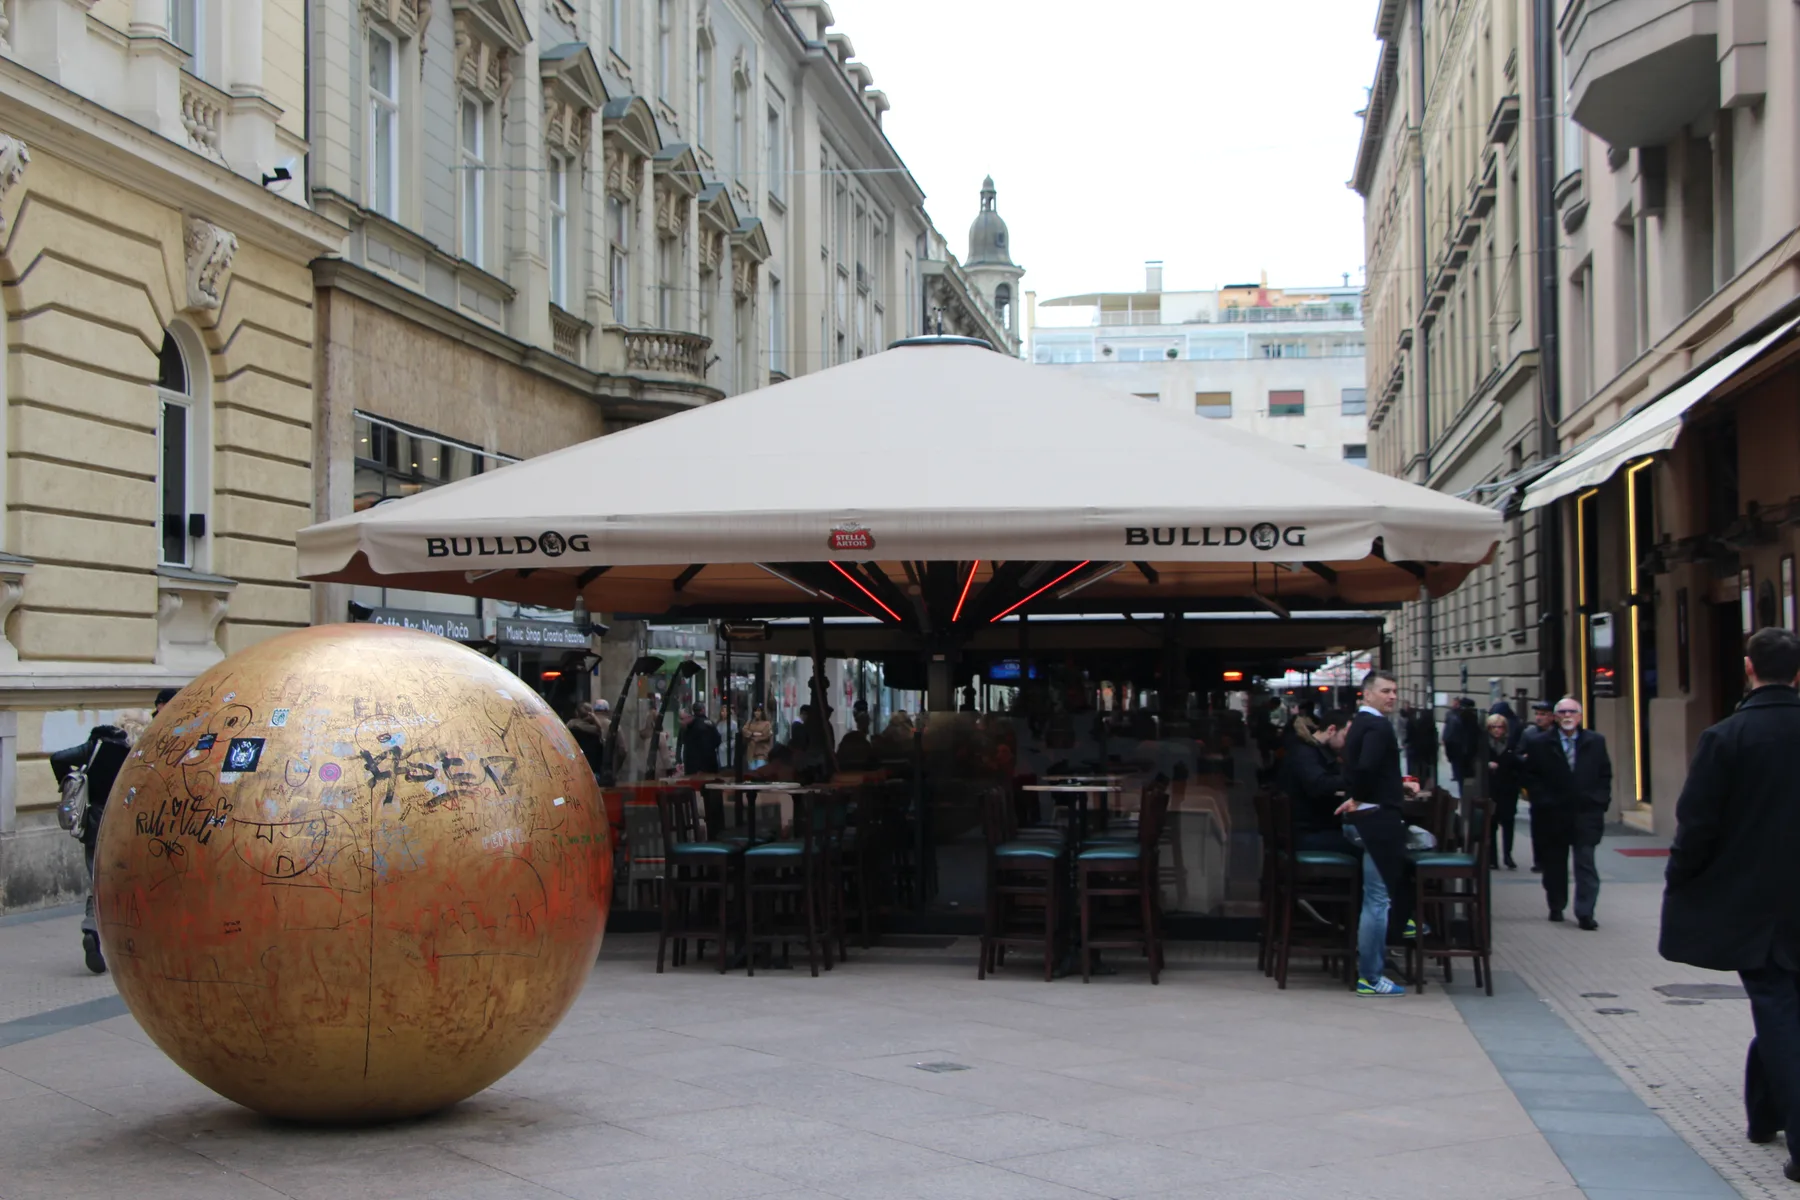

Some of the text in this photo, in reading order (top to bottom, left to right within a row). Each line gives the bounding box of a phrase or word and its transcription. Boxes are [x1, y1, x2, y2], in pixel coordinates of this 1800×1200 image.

[426, 530, 591, 557] BULLDOG
[1124, 522, 1307, 550] BULLDOG
[506, 625, 524, 641] Music
[526, 626, 540, 644] Shop
[542, 627, 564, 643] Croatia
